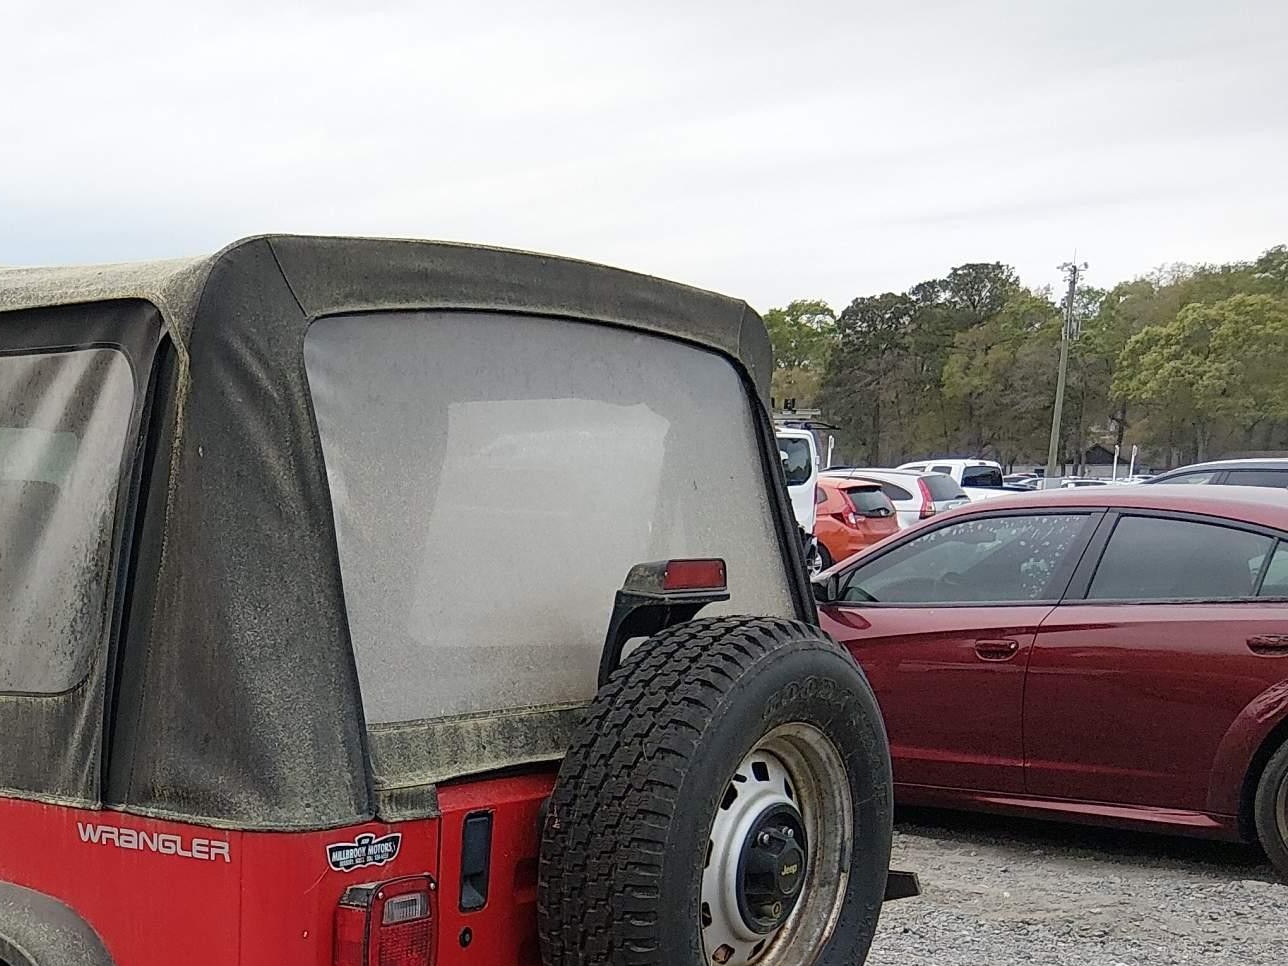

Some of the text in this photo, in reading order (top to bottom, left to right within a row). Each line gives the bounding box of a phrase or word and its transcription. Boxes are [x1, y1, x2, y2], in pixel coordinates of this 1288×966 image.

[77, 821, 232, 864] WRANGLER
[331, 846, 367, 863] MILLBROOK
[781, 863, 798, 876] Jeep
